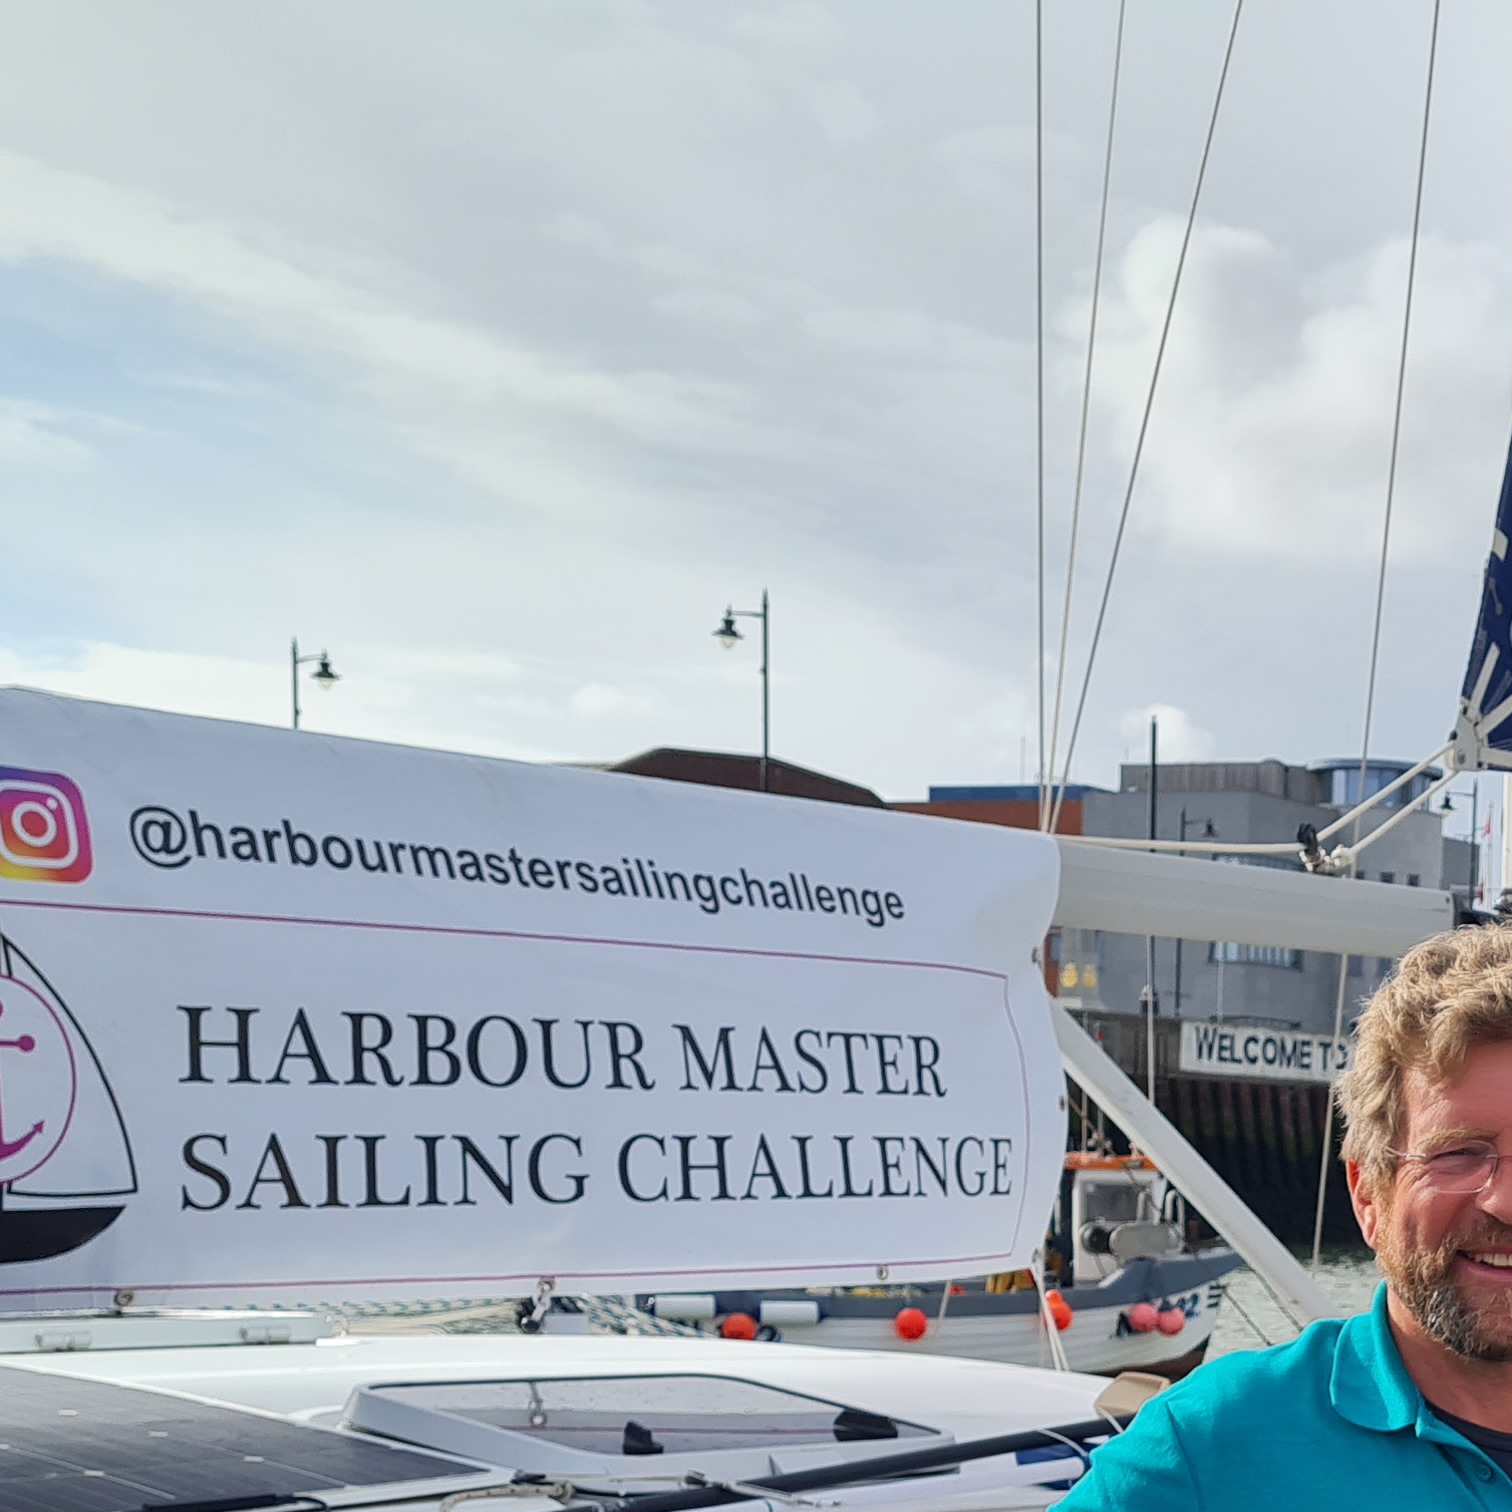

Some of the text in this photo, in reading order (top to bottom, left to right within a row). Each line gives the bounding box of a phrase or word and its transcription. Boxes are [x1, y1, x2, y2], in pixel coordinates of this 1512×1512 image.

[129, 804, 905, 928] @harbourmastersailingchallenge
[177, 1005, 947, 1098] HARBOUR MASTER
[1195, 1026, 1312, 1071] WELCOME
[181, 1133, 1012, 1212] SAILING CHALLENGE
